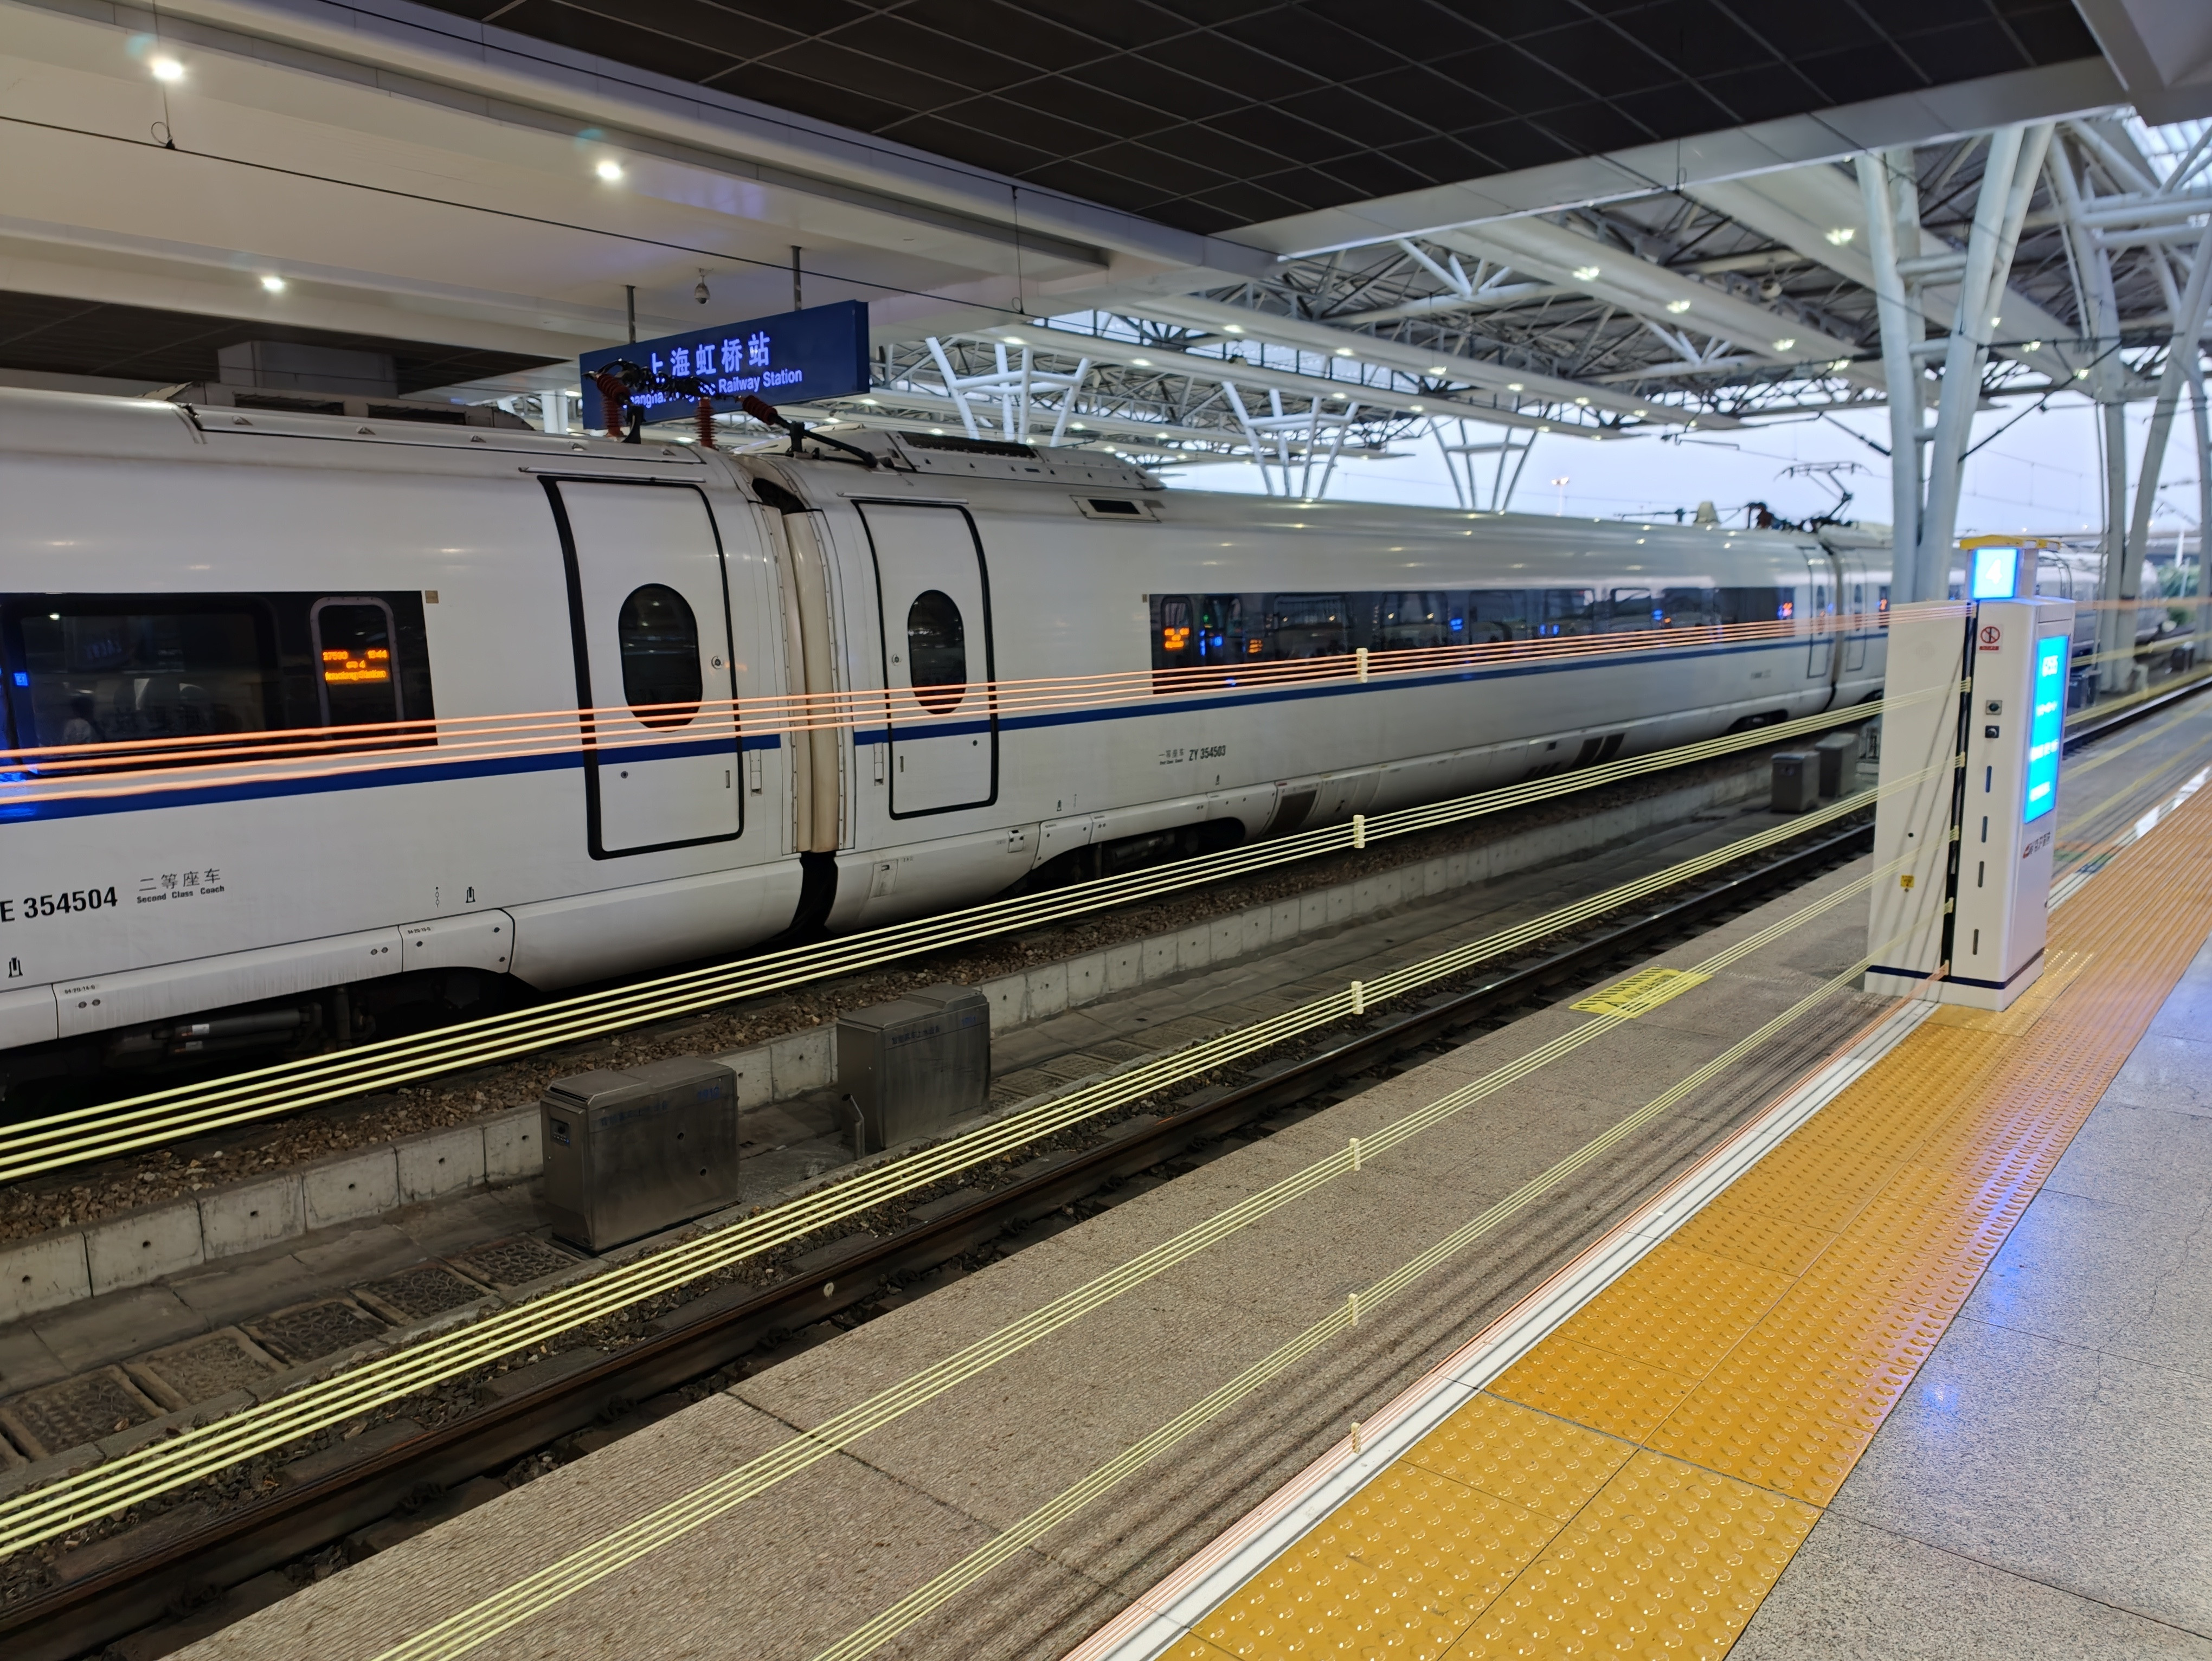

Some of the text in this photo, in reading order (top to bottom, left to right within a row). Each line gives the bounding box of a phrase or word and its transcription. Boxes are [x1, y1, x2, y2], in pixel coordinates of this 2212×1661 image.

[646, 331, 770, 384] 上海虹桥站
[718, 376, 760, 393] Railway
[763, 368, 802, 388] Station
[1985, 559, 2003, 585] 4
[139, 868, 221, 891] 二等座车
[0, 886, 118, 922] E 354504
[137, 885, 224, 904] Second Class Coach
